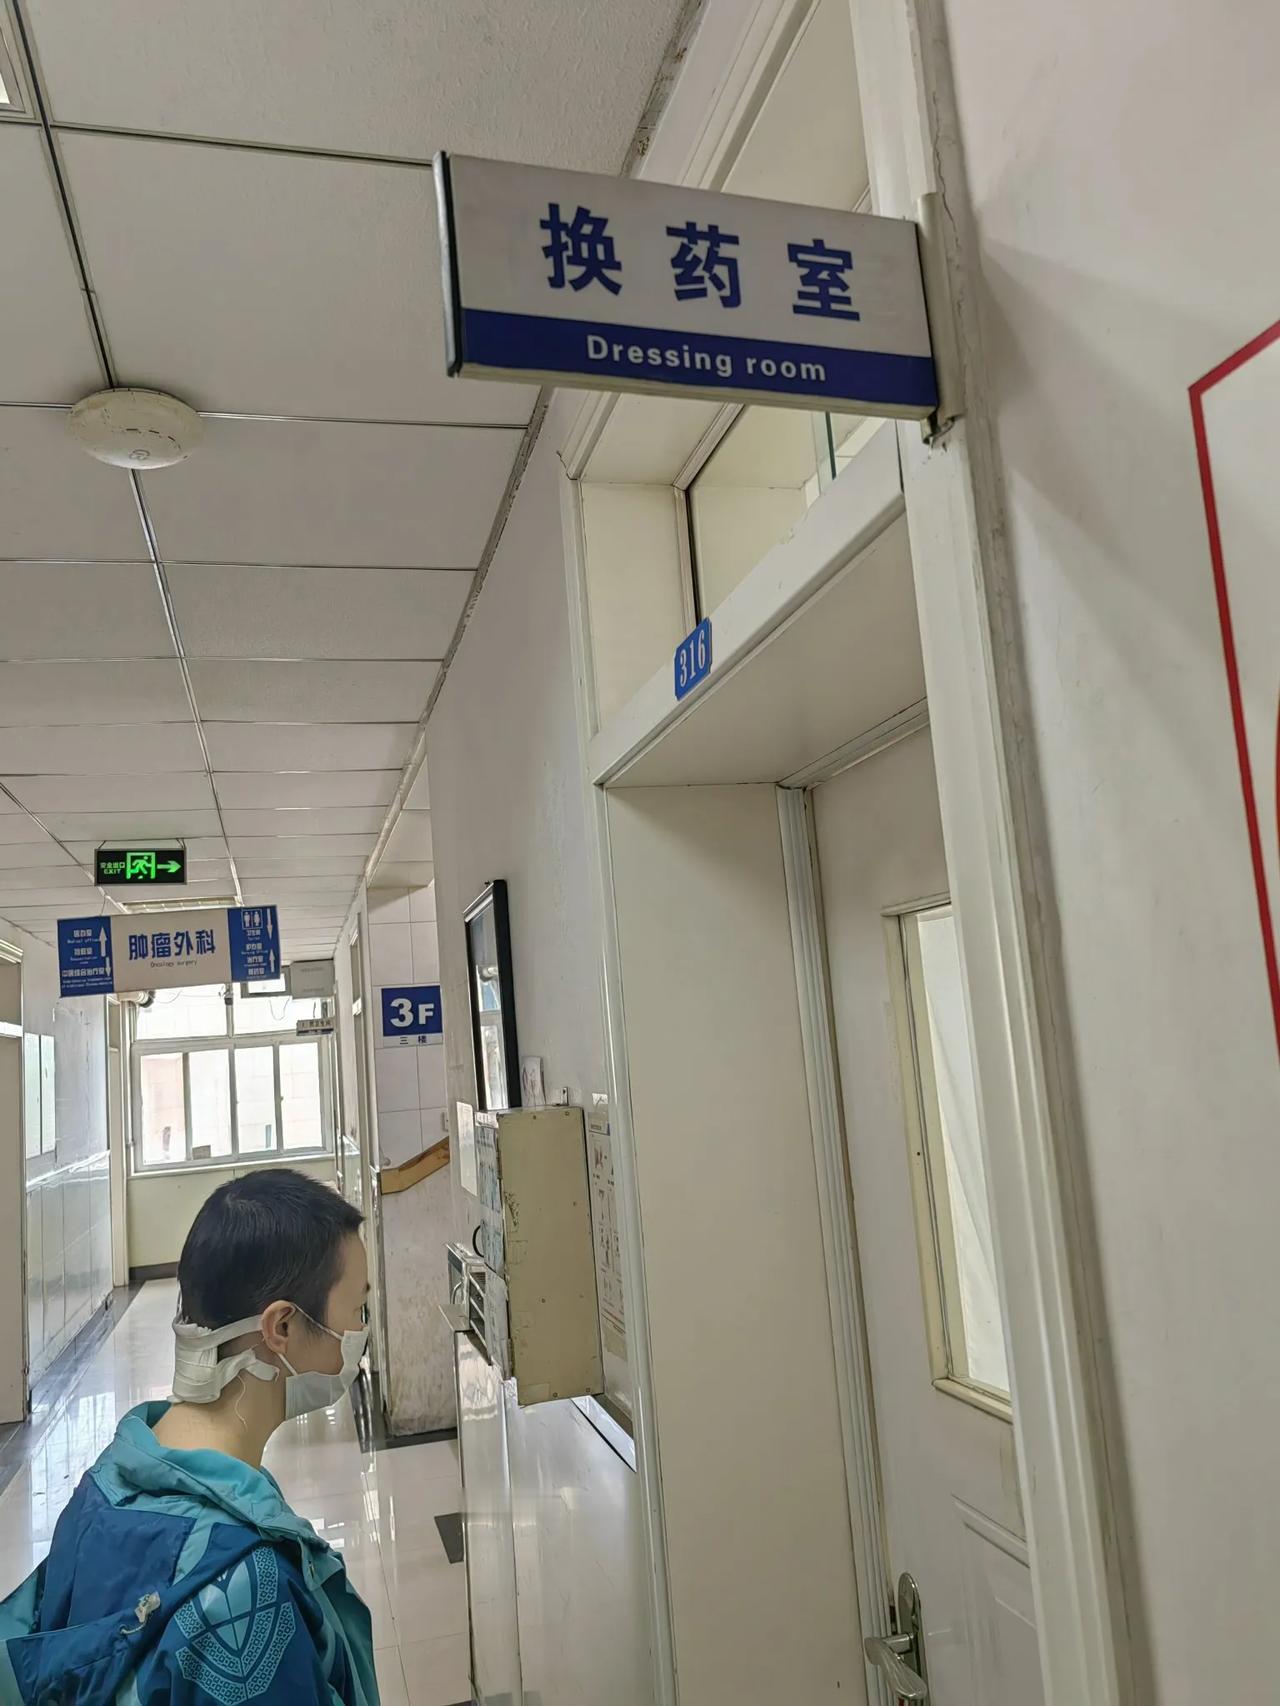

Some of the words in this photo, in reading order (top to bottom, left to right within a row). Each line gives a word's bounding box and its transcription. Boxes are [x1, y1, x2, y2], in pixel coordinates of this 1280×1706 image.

[540, 203, 860, 322] 换药室
[587, 334, 732, 378] Dressing
[746, 357, 827, 382] room
[680, 629, 706, 688] 316
[128, 929, 216, 960] 肿瘤外科
[390, 998, 435, 1028] 3F
[399, 1035, 428, 1045] 三楼
